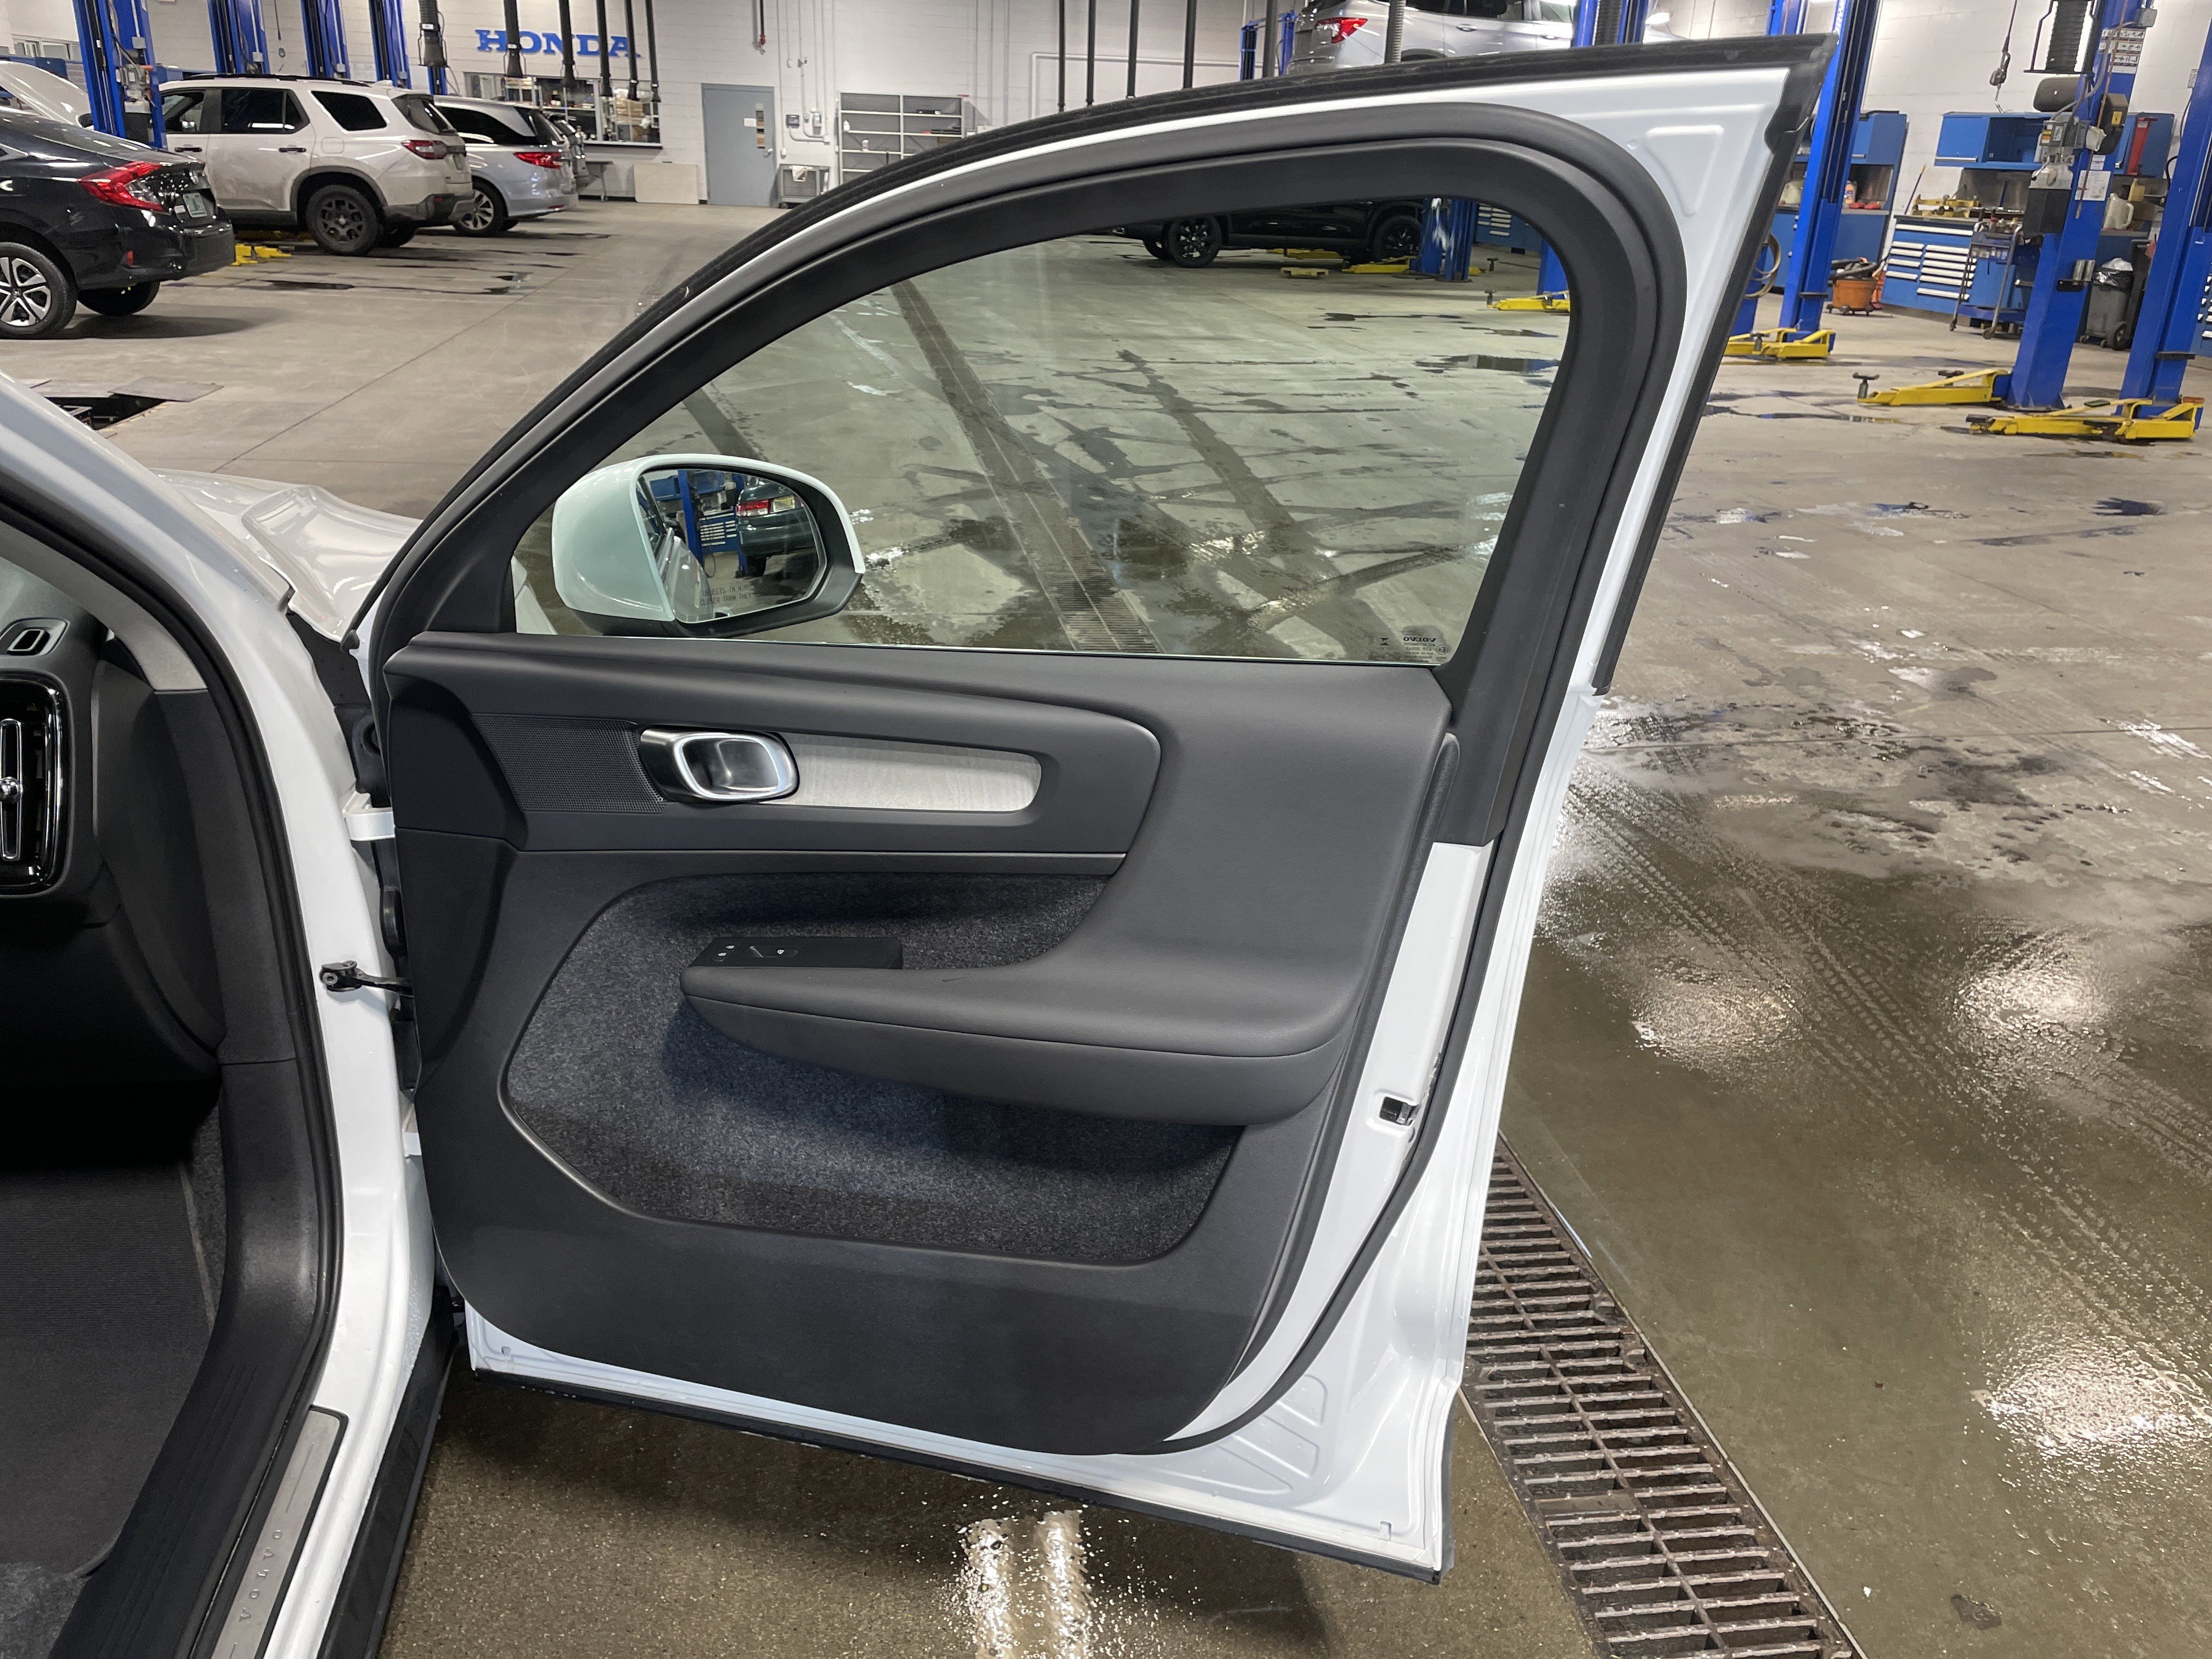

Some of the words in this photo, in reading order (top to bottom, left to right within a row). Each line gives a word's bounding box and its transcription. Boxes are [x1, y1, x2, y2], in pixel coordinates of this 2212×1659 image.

[475, 29, 642, 58] HONDA
[700, 596, 720, 606] CLOSER
[723, 594, 736, 602] THAN
[239, 1530, 283, 1622] VOLVO
